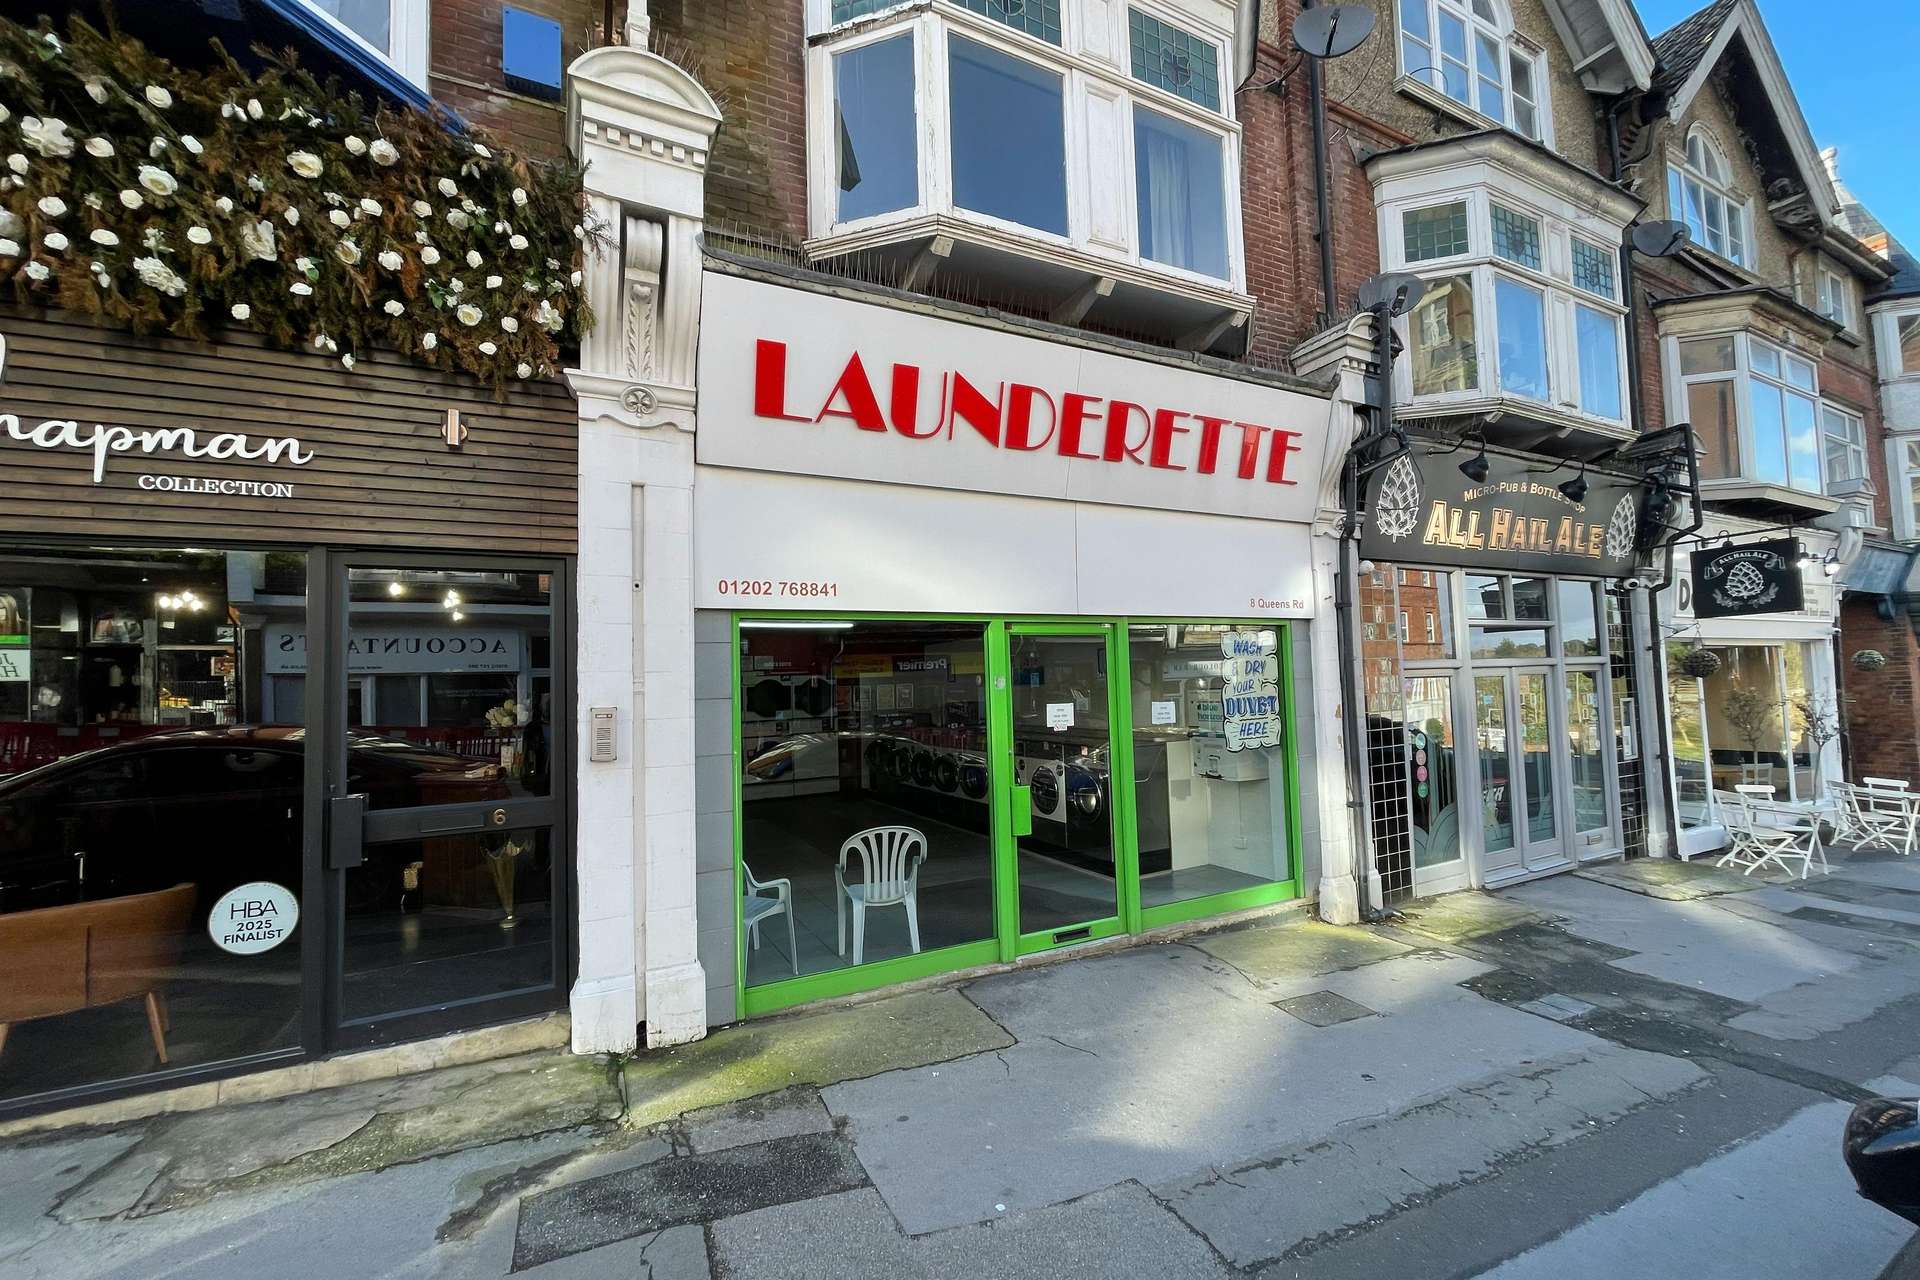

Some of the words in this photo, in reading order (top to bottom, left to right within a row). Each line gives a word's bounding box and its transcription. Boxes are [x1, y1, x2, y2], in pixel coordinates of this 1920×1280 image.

[755, 339, 1303, 485] LAUNDERETTE
[138, 474, 293, 498] COLLECTION
[1520, 482, 1527, 493] &
[1423, 499, 1485, 550] ALL
[1488, 507, 1553, 554] HAIL
[1552, 515, 1605, 560] ALE
[718, 580, 773, 596] 01202
[778, 581, 838, 597] 768841
[1250, 598, 1255, 608] 8
[1258, 598, 1290, 609] Queens
[1292, 599, 1304, 609] Rd
[1244, 660, 1266, 674] DRY
[1233, 679, 1254, 693] YOUR
[1225, 695, 1277, 718] DUVET
[1239, 721, 1269, 736] HERE
[493, 808, 506, 825] 6
[230, 899, 278, 920] HBA
[236, 919, 272, 932] 2025
[223, 928, 284, 945] FINALIST
